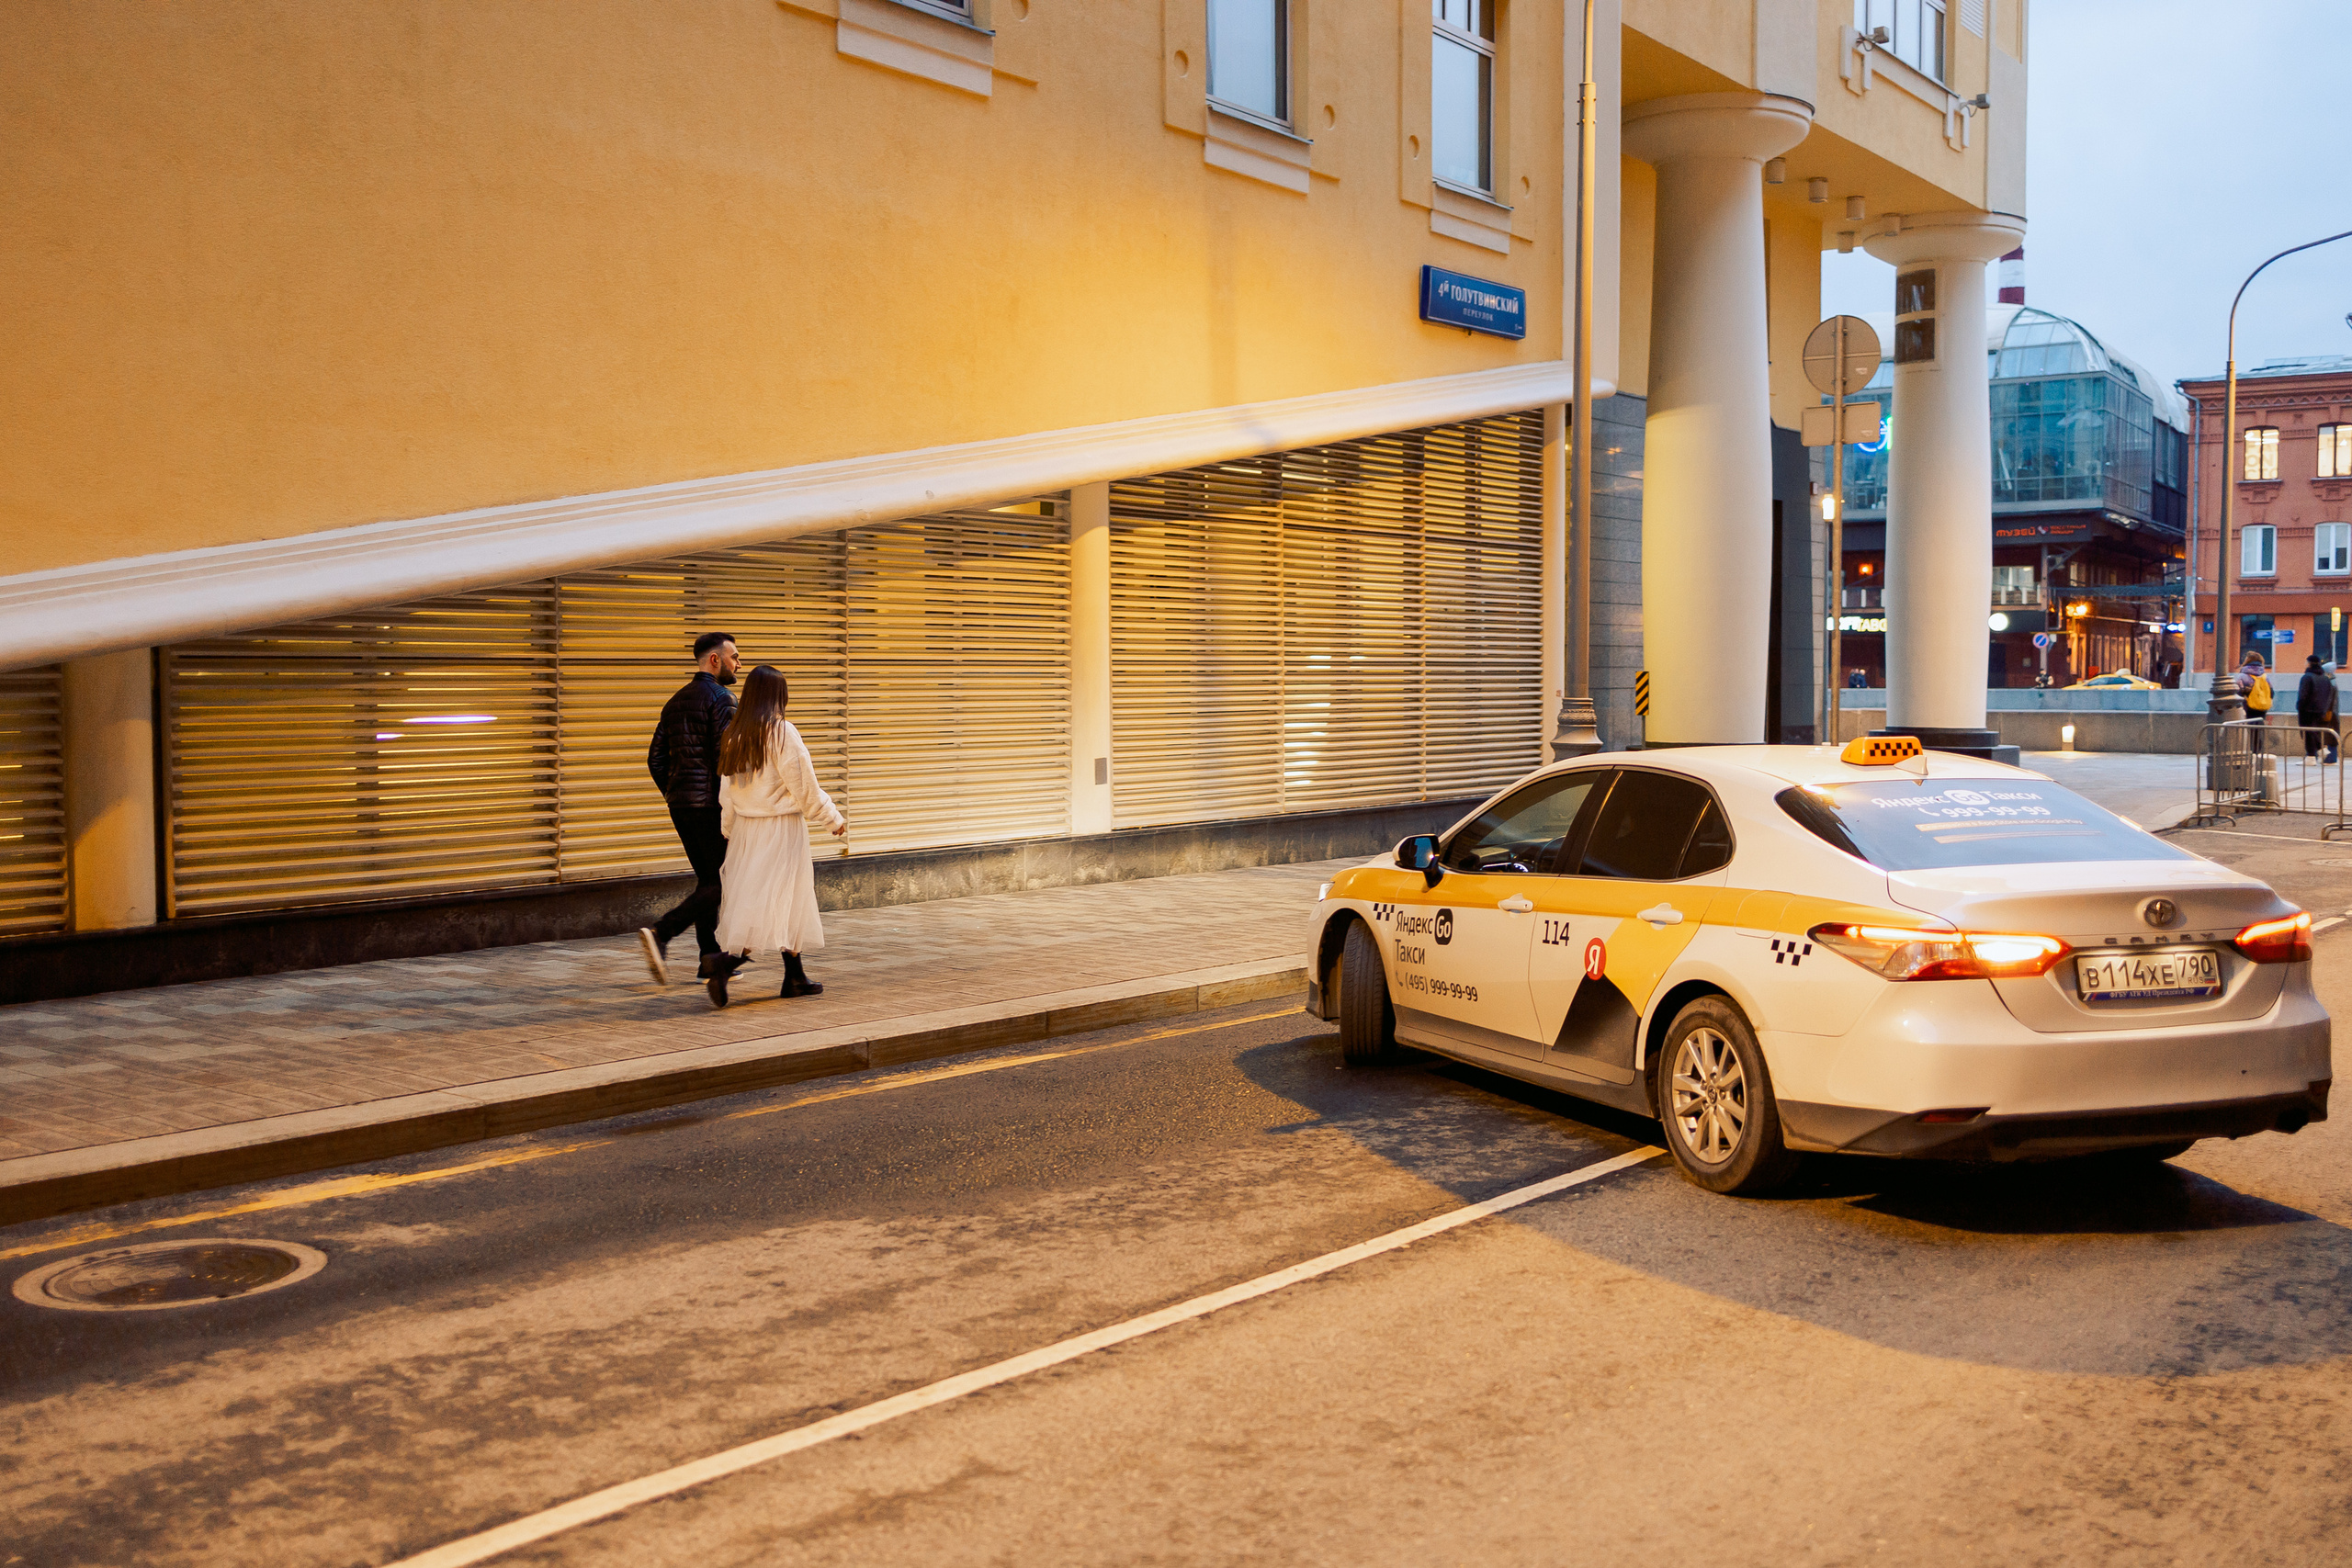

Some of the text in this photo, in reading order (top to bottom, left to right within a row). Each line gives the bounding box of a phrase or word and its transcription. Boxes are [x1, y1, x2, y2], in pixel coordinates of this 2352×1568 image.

[1451, 285, 1519, 314] ГОЛУТВИНСКИЙ
[1463, 308, 1494, 321] ПЕРЕУЛОК
[1871, 795, 1951, 808] Яндекс
[1979, 791, 2043, 801] Такси
[1940, 806, 2051, 818] 999-99-99
[1396, 910, 1453, 939] Яндекс Go
[1543, 919, 1570, 946] 114
[2104, 932, 2215, 945] CAMRY
[1395, 939, 1425, 965] Такси
[1587, 944, 1601, 976] Я
[1405, 972, 1478, 1002] (495) 999-99-99
[2188, 976, 2204, 985] RUS
